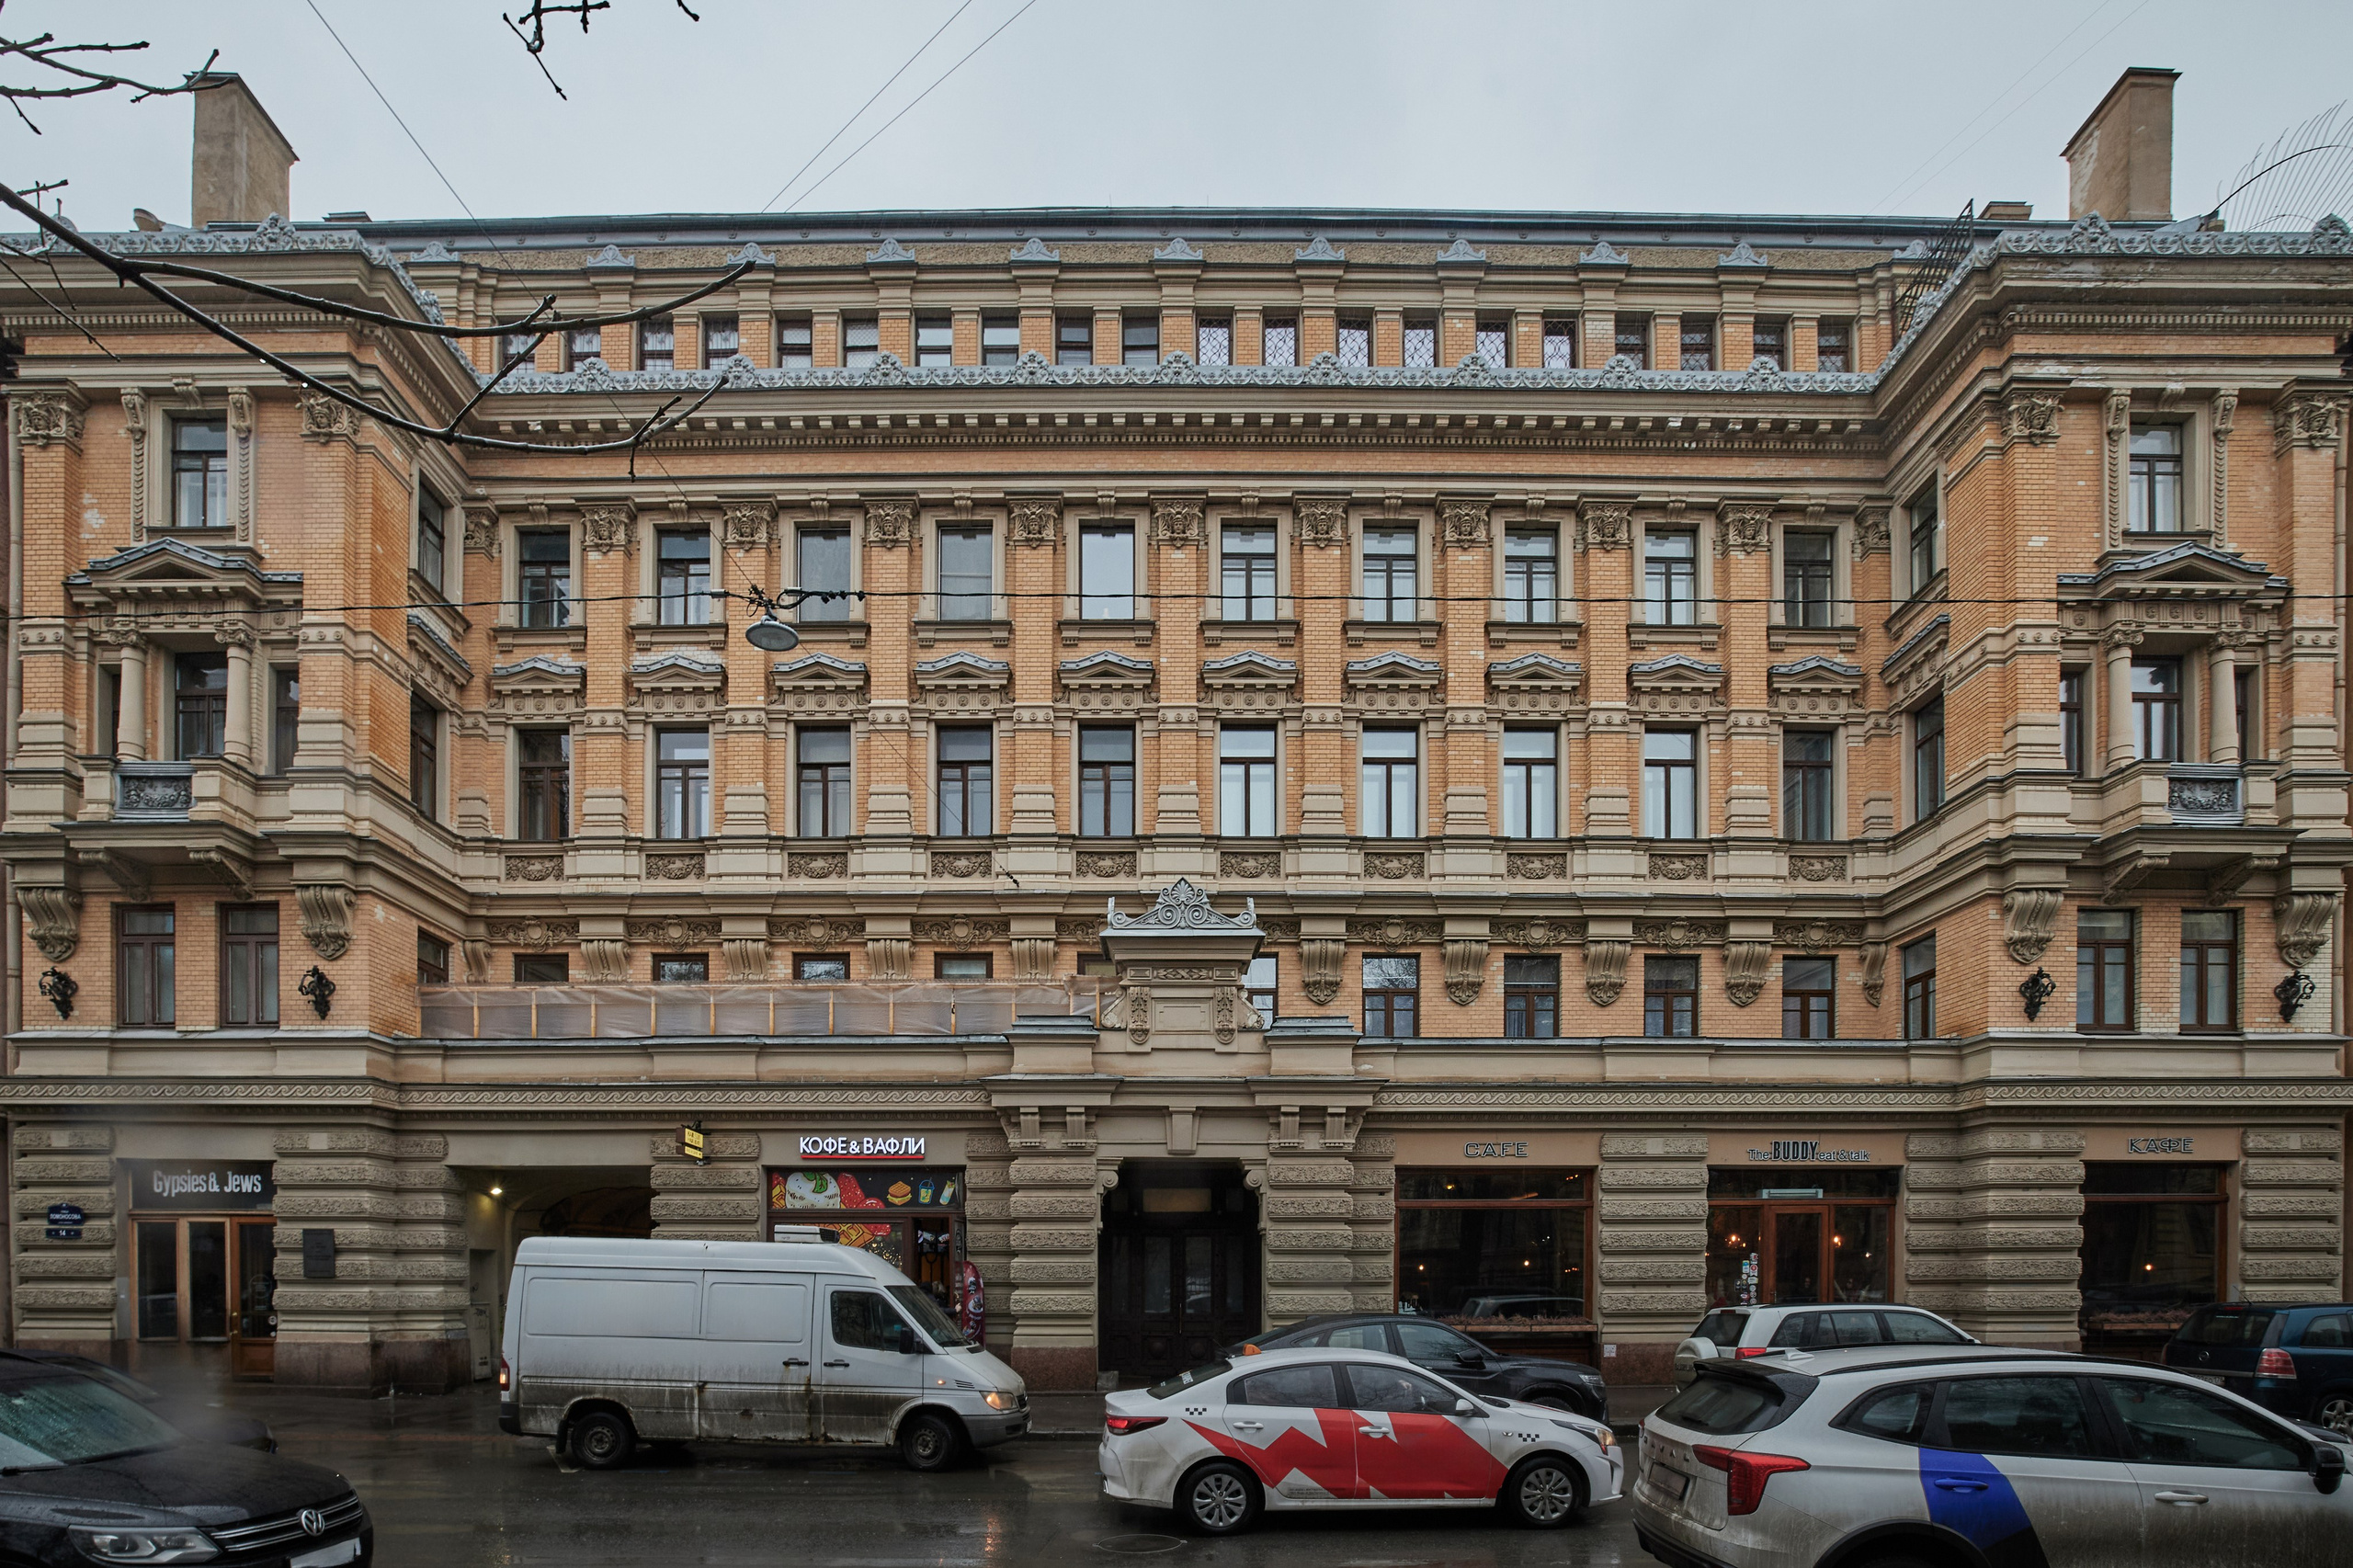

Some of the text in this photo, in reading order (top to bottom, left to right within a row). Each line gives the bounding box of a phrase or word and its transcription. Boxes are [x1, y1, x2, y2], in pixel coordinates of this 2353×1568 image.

[800, 1136, 926, 1154] КОФЕ & ВАФЛИ
[1464, 1142, 1529, 1157] CAFE
[1747, 1140, 1870, 1162] The BUDDY eat & talk
[2128, 1137, 2195, 1153] КАФЕ
[153, 1168, 262, 1197] Gypsies & Jews
